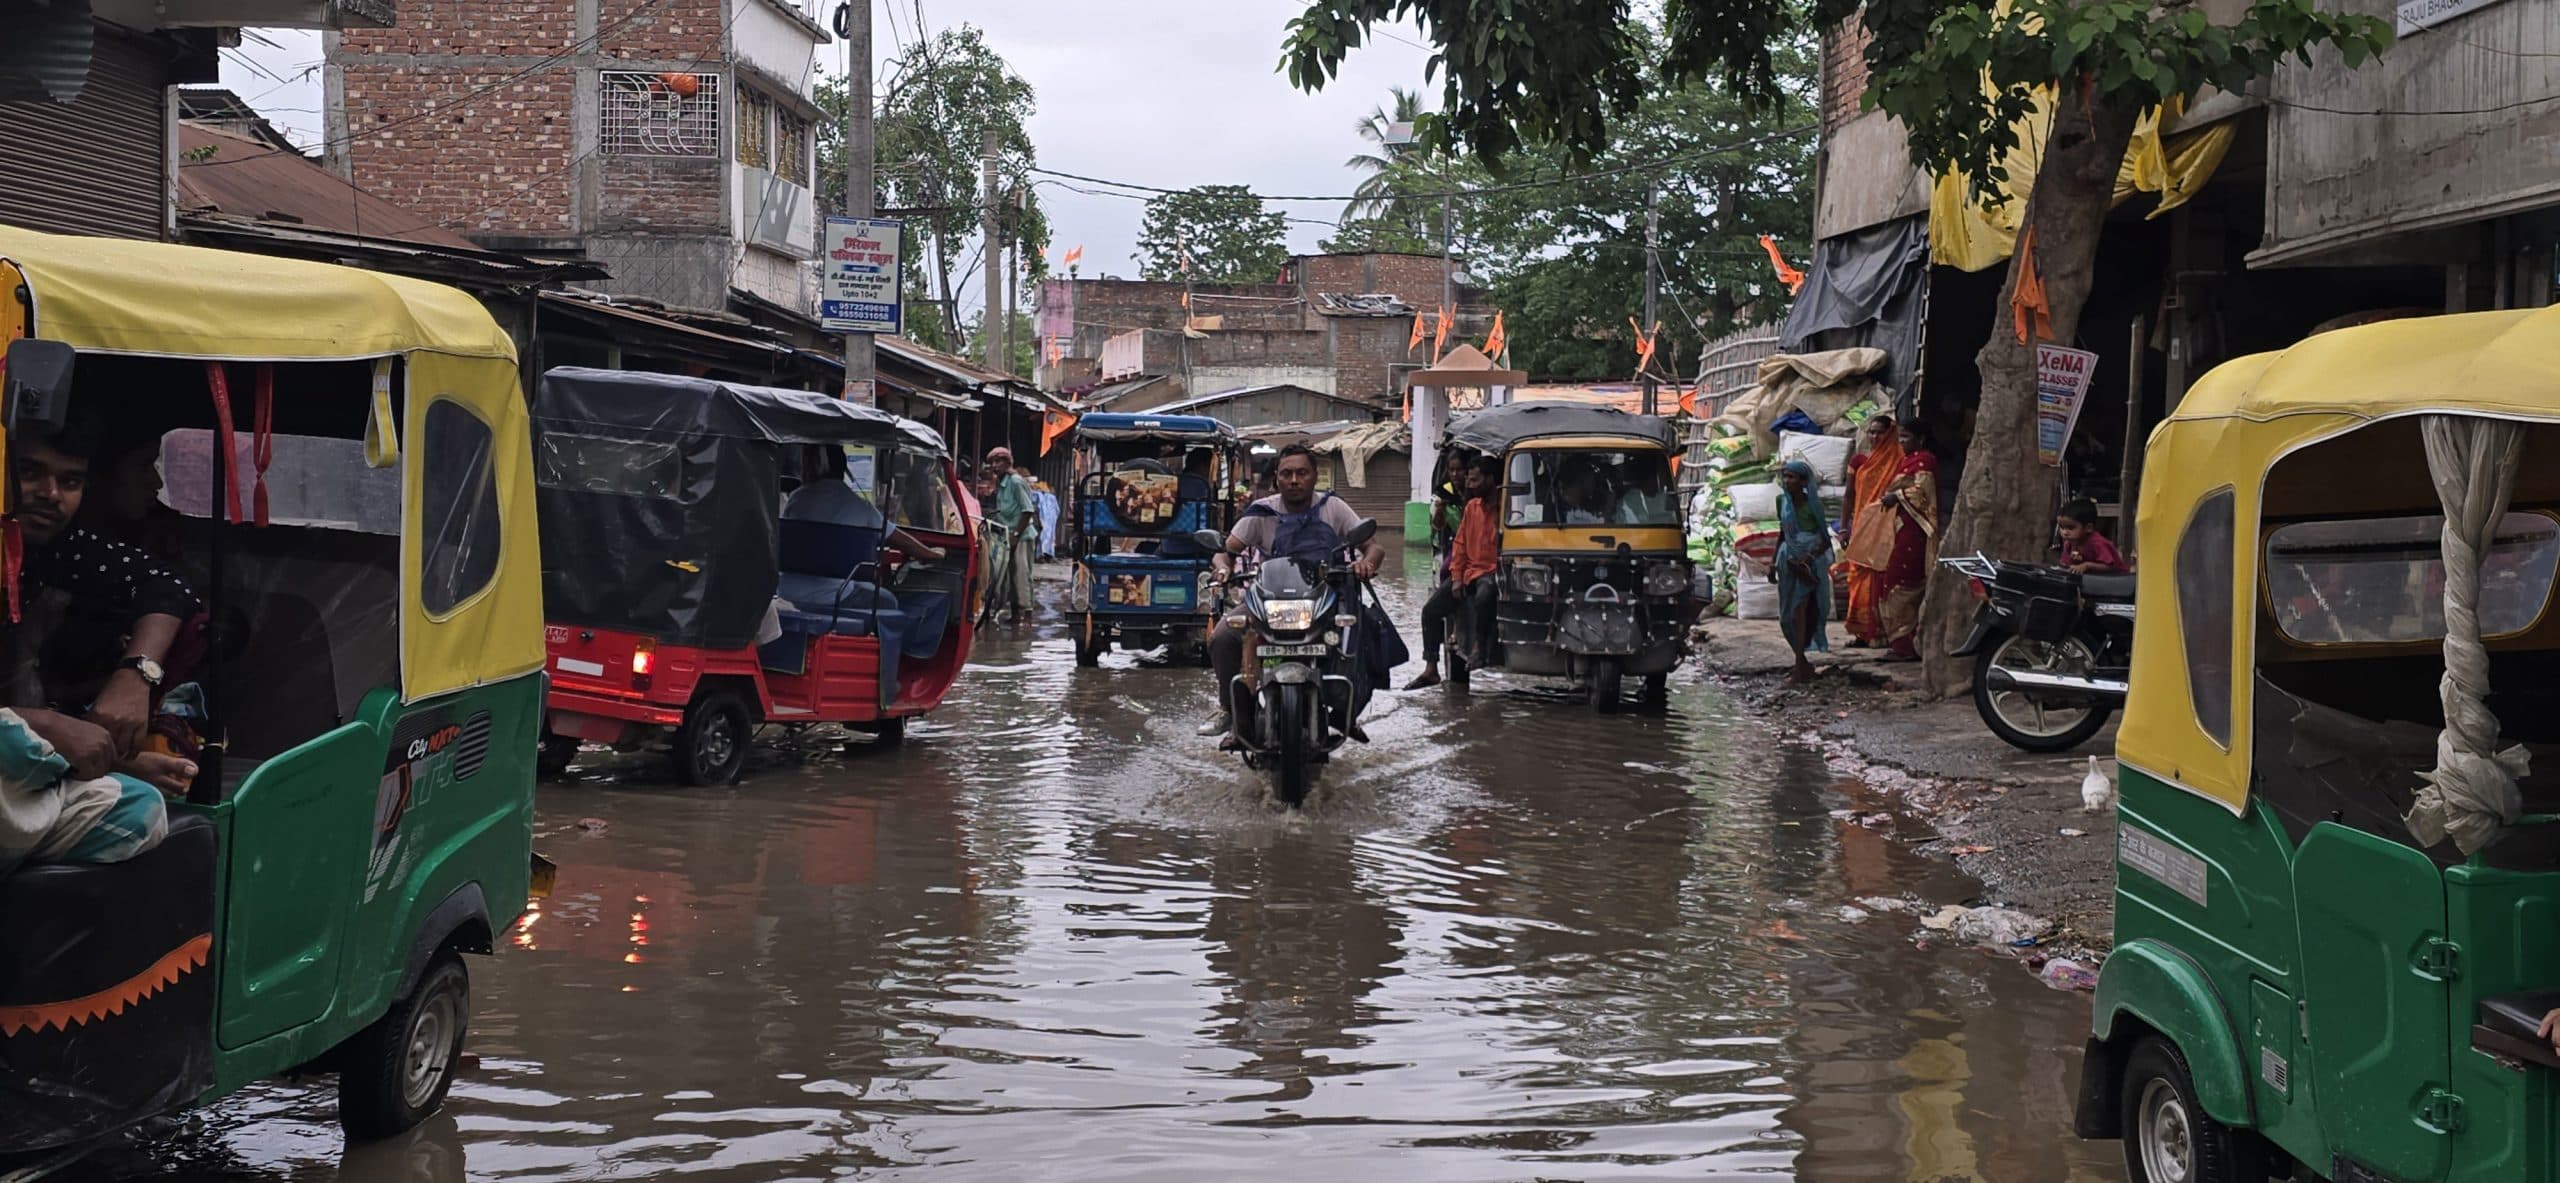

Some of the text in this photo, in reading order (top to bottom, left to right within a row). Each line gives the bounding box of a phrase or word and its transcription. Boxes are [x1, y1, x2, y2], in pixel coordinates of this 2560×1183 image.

[2403, 4, 2427, 24] RAJU
[2040, 351, 2084, 374] XeNA
[2038, 371, 2080, 387] CLASSES
[407, 738, 429, 760] City
